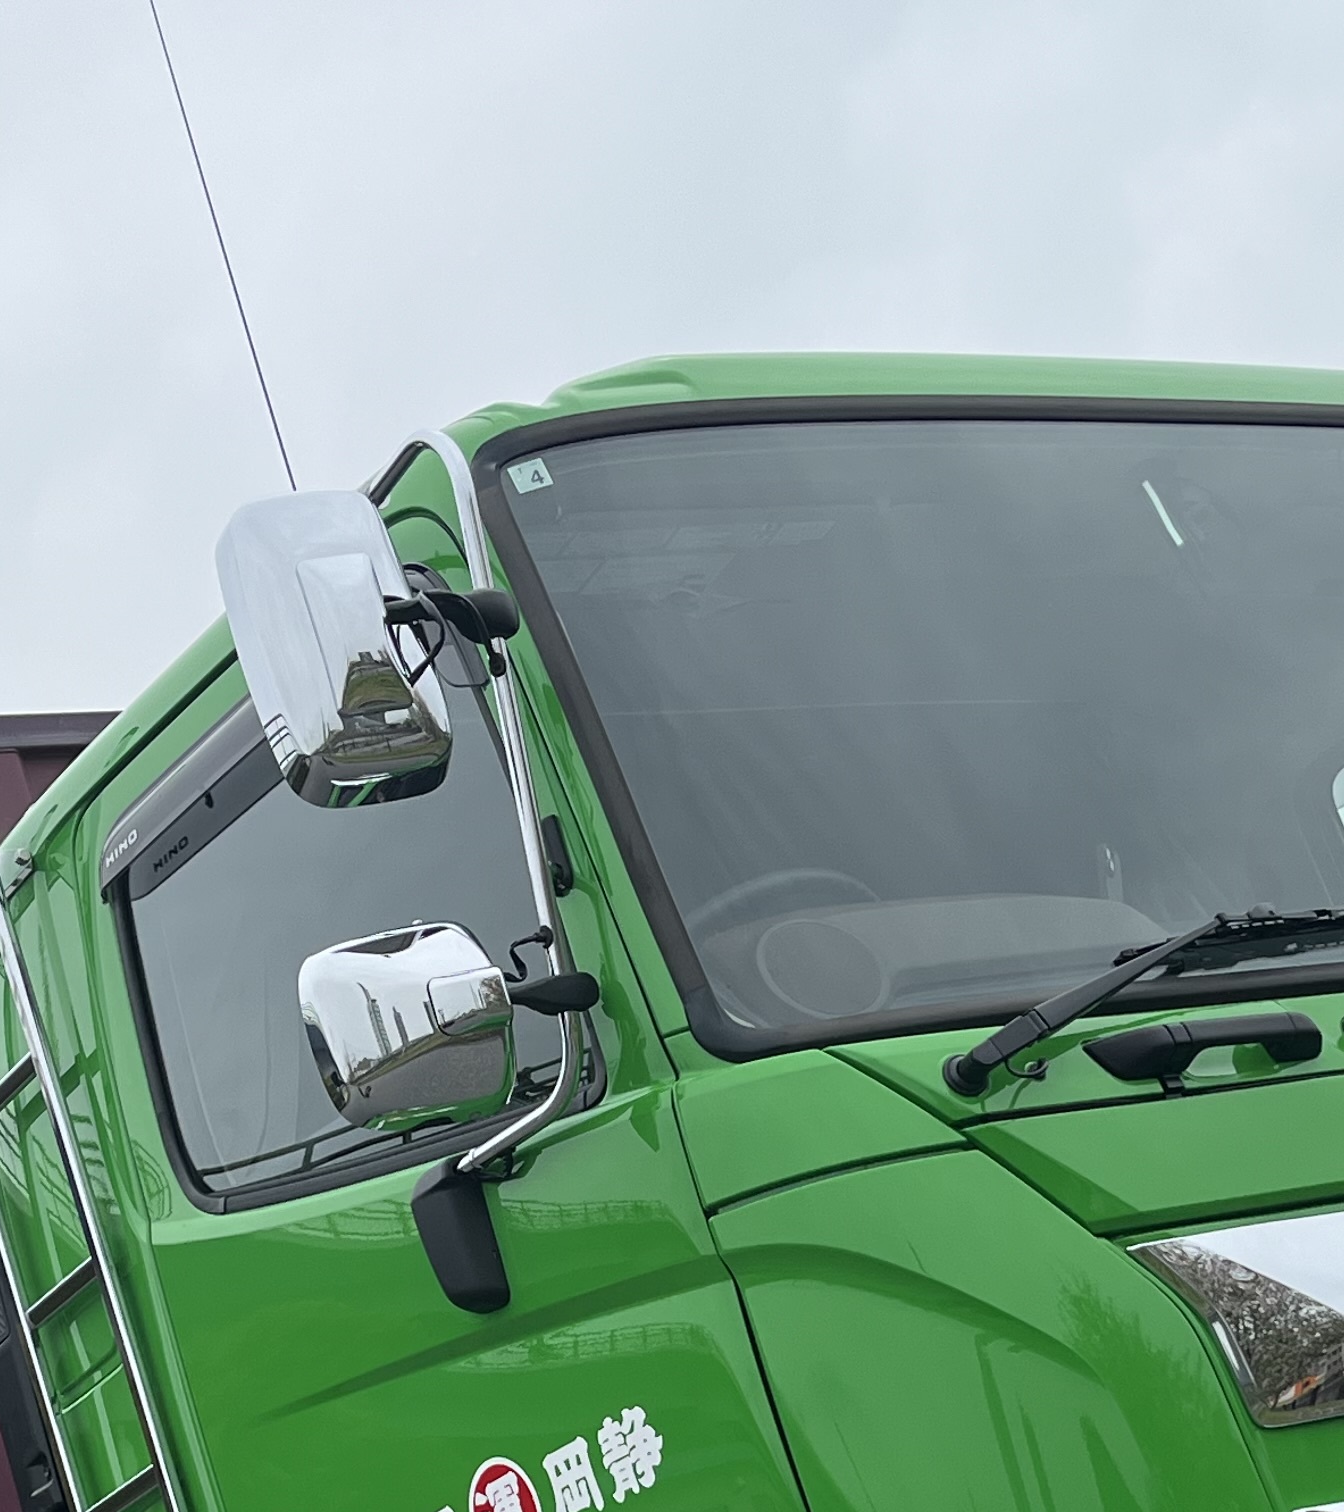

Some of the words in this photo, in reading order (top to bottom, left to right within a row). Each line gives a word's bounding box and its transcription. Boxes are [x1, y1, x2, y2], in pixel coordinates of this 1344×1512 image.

[531, 469, 545, 484] 4
[105, 829, 138, 868] HINO
[152, 835, 189, 873] HINO
